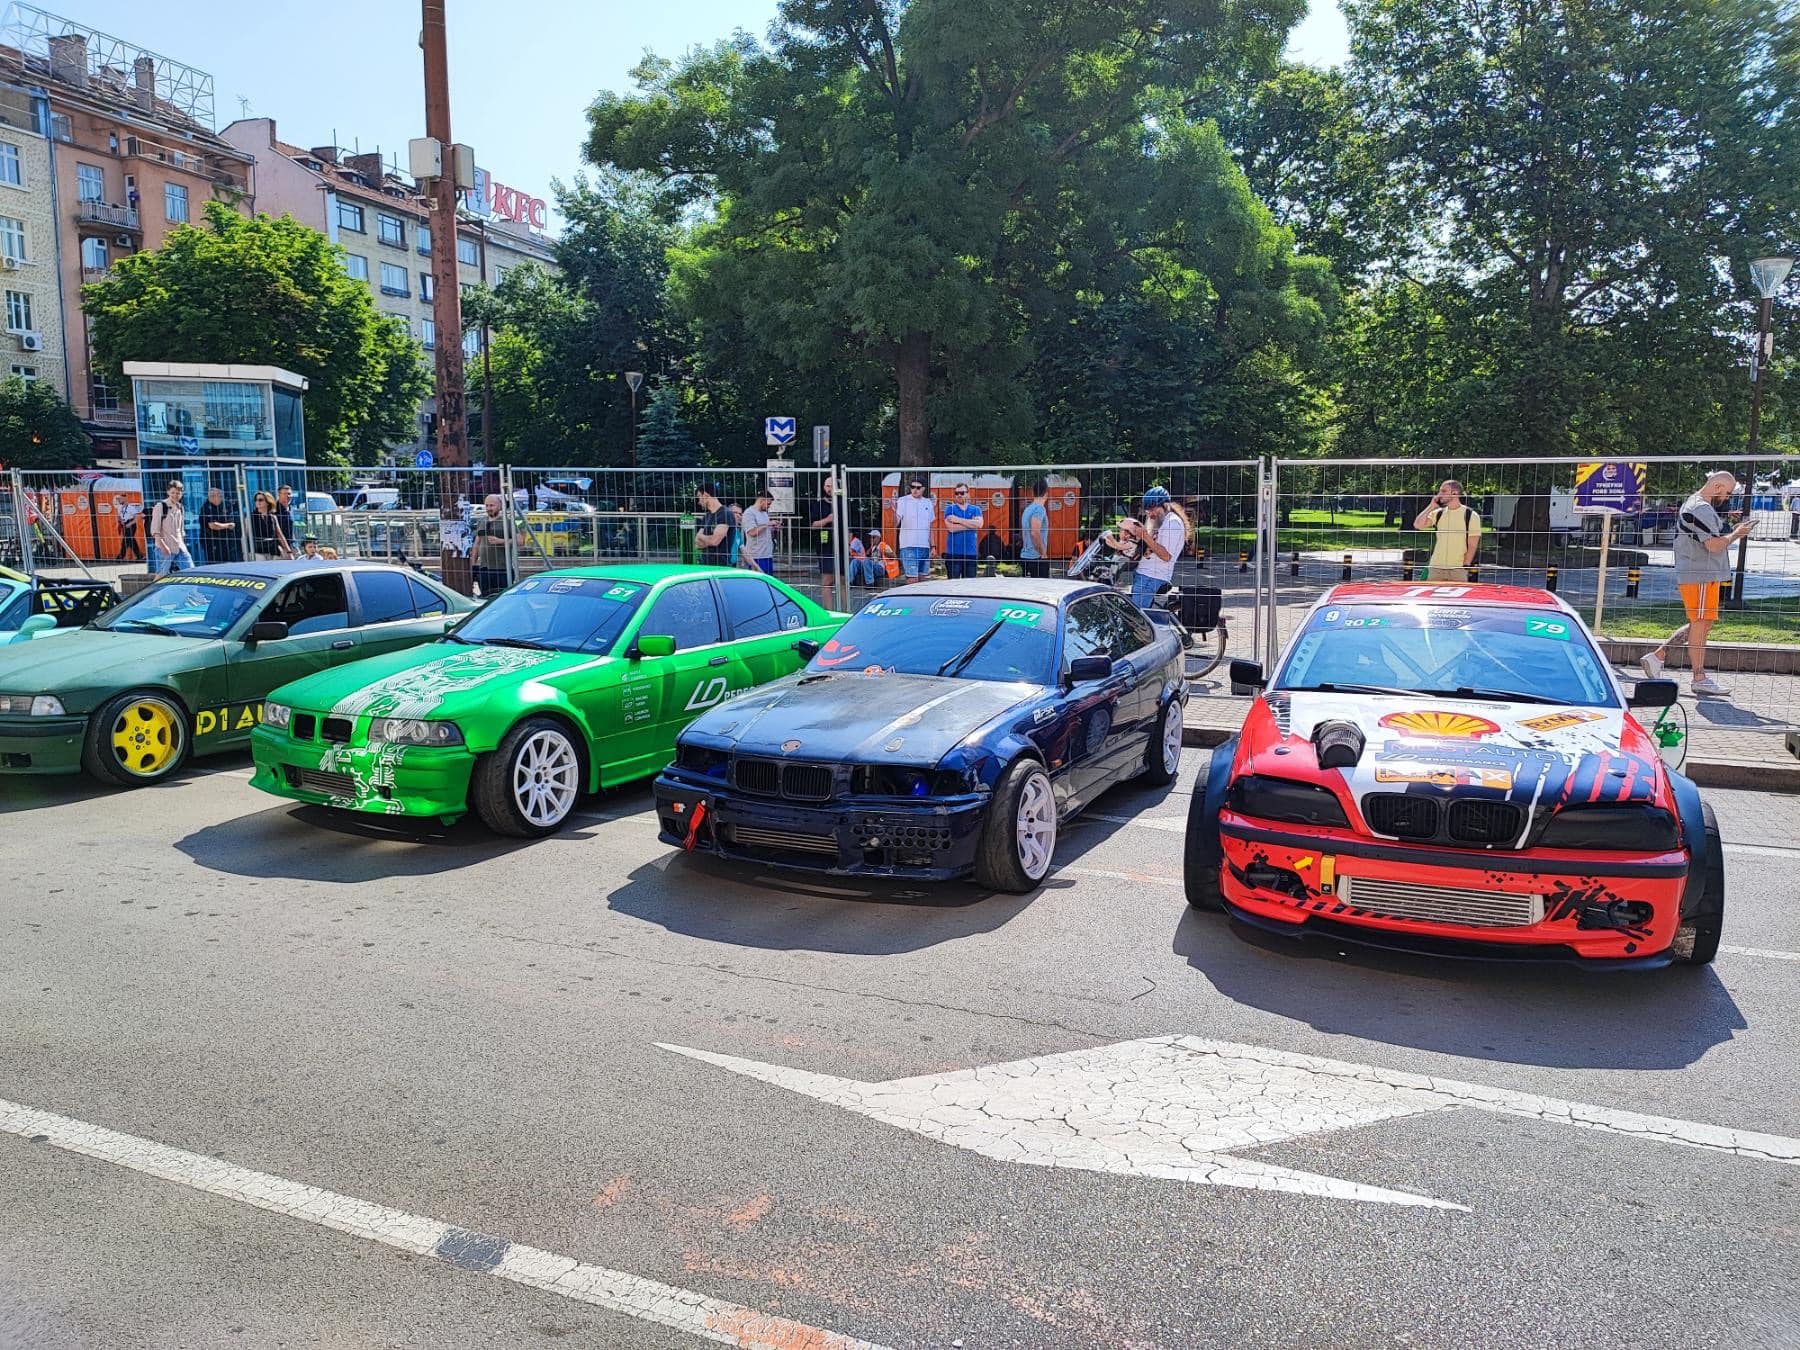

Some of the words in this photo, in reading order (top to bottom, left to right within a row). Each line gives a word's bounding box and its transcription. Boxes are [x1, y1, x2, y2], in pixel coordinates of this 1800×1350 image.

[493, 182, 545, 229] KFC
[607, 587, 636, 597] 61
[1401, 586, 1473, 597] 79
[1001, 608, 1041, 621] 101
[1325, 610, 1340, 622] 9
[1368, 618, 1381, 626] 2
[1530, 620, 1566, 634] 79
[684, 677, 727, 711] LD
[196, 707, 228, 736] D1
[1418, 757, 1507, 767] PERFORMANCE
